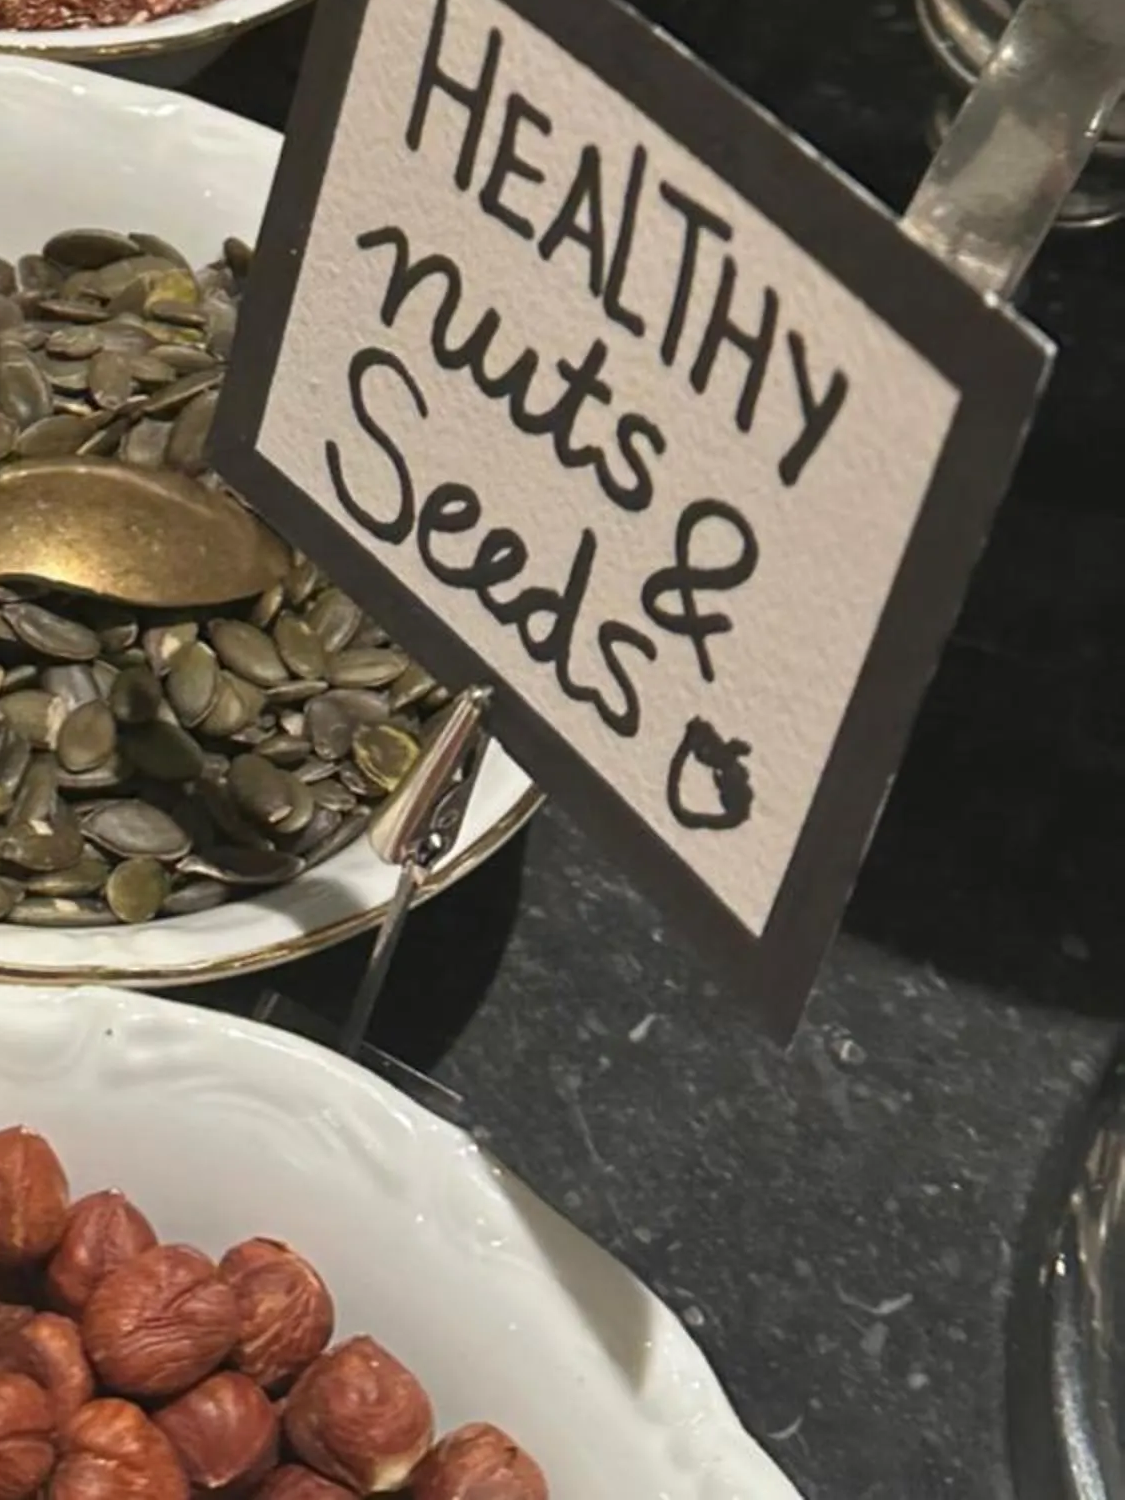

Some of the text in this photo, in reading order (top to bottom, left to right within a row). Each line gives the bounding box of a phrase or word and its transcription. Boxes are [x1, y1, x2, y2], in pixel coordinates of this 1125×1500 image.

[324, 347, 657, 739] Seeds
[357, 225, 758, 684] nuts &
